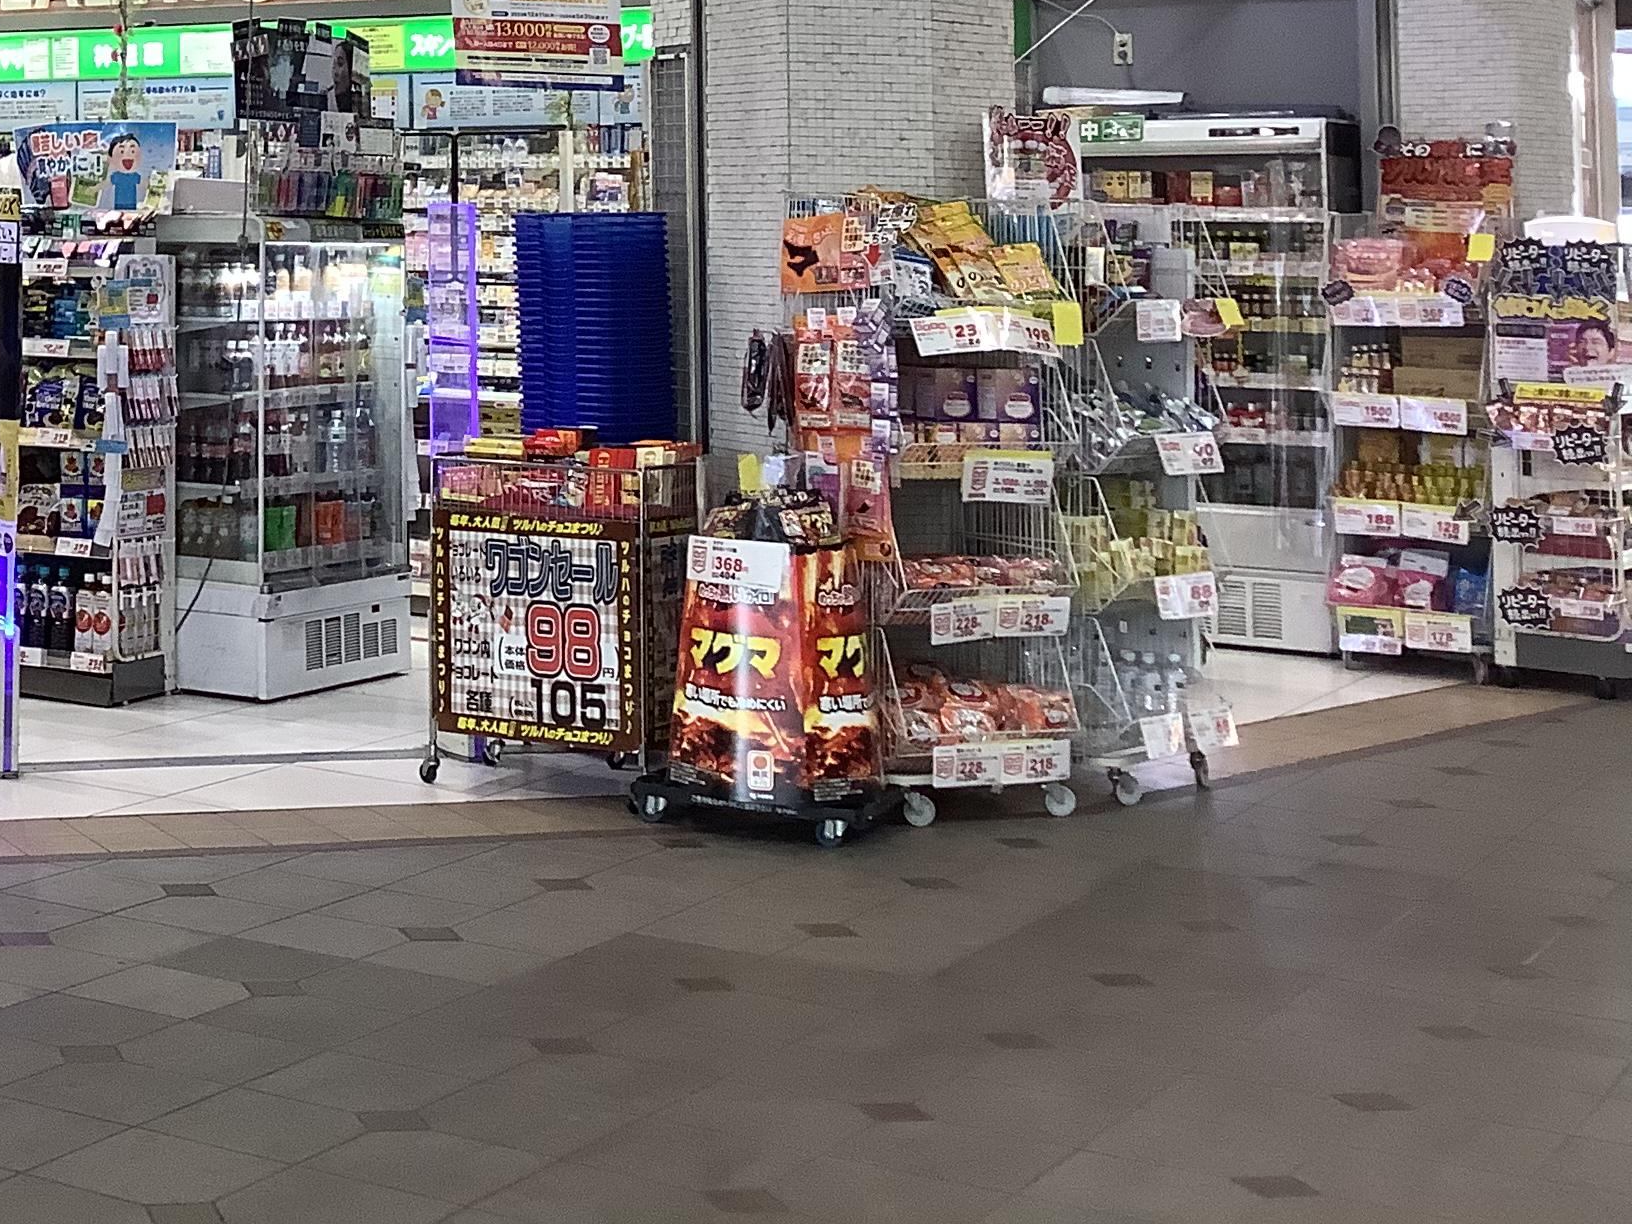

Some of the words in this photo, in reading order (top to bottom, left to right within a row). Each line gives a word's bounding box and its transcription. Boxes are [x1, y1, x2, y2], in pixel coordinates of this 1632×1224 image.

[1024, 326, 1051, 342] 198
[1366, 513, 1395, 526] 188
[1436, 520, 1461, 534] 128
[485, 535, 618, 606] ワゴンセール
[714, 556, 744, 572] 368
[454, 637, 491, 659] ワゴン内
[525, 600, 604, 682] 98
[689, 627, 782, 679] マグマ
[531, 678, 607, 730] 105
